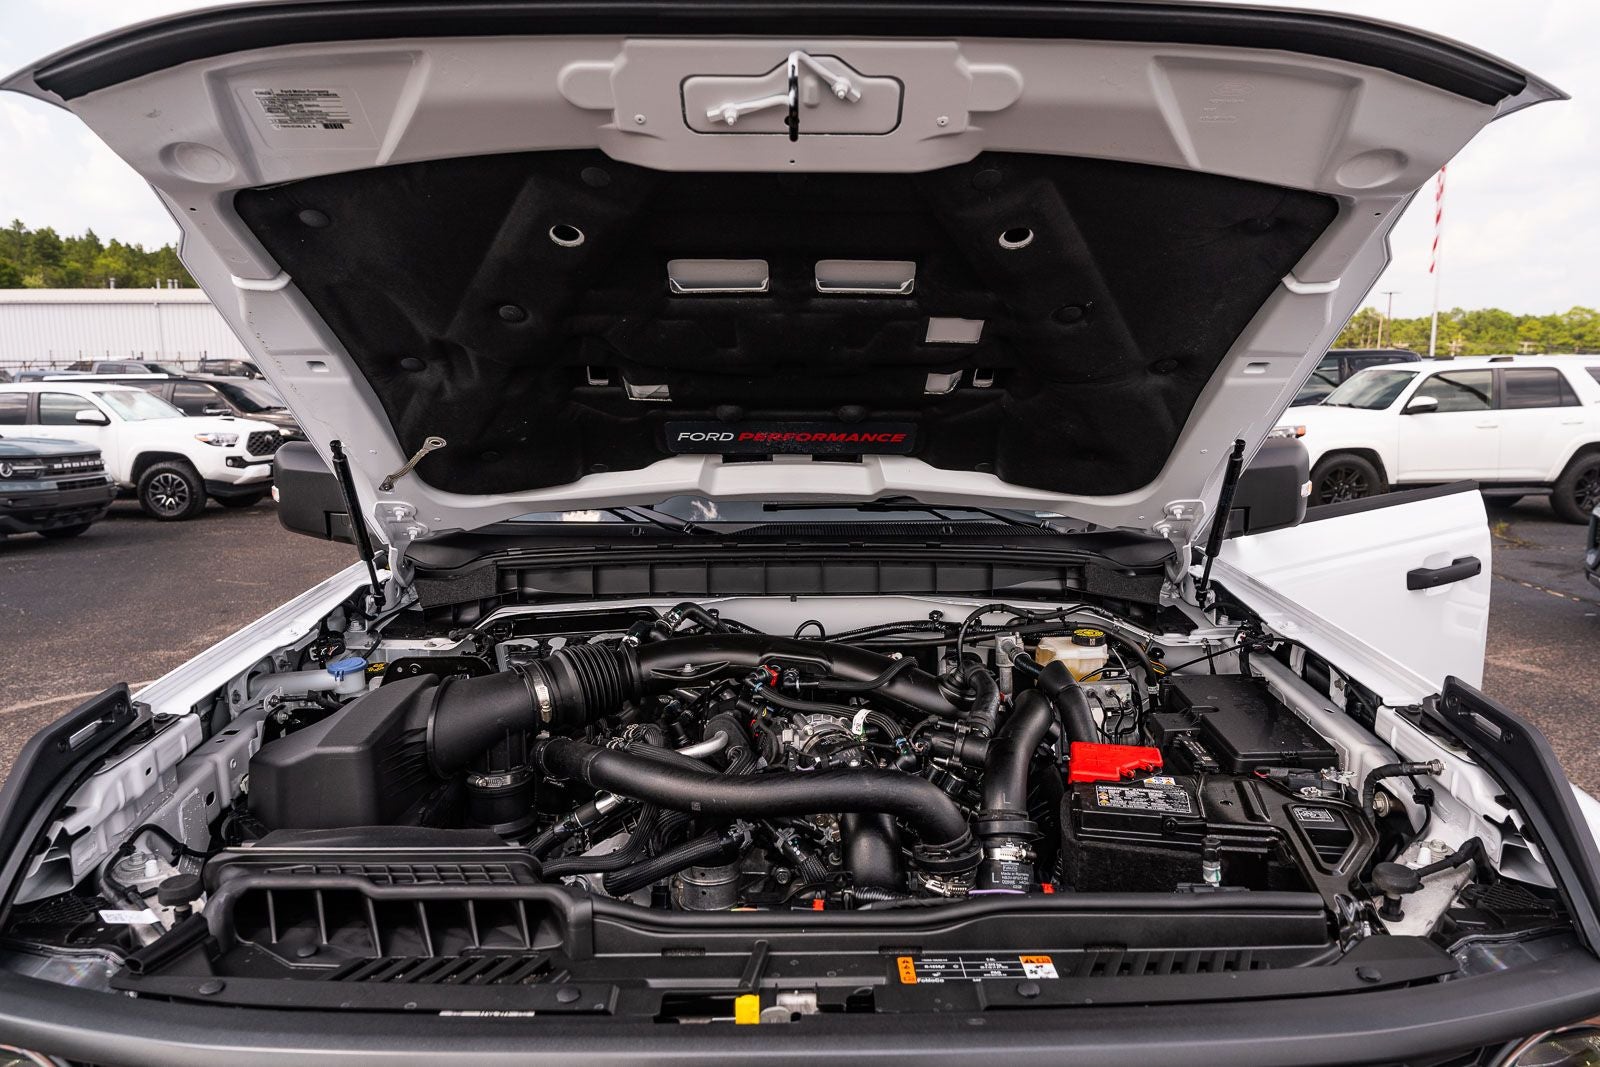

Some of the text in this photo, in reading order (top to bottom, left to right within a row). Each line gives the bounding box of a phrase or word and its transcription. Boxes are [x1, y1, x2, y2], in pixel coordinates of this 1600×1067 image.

[677, 432, 907, 443] FORD PERFORMANCE
[53, 460, 101, 469] BRONCO
[991, 872, 1000, 884] L
